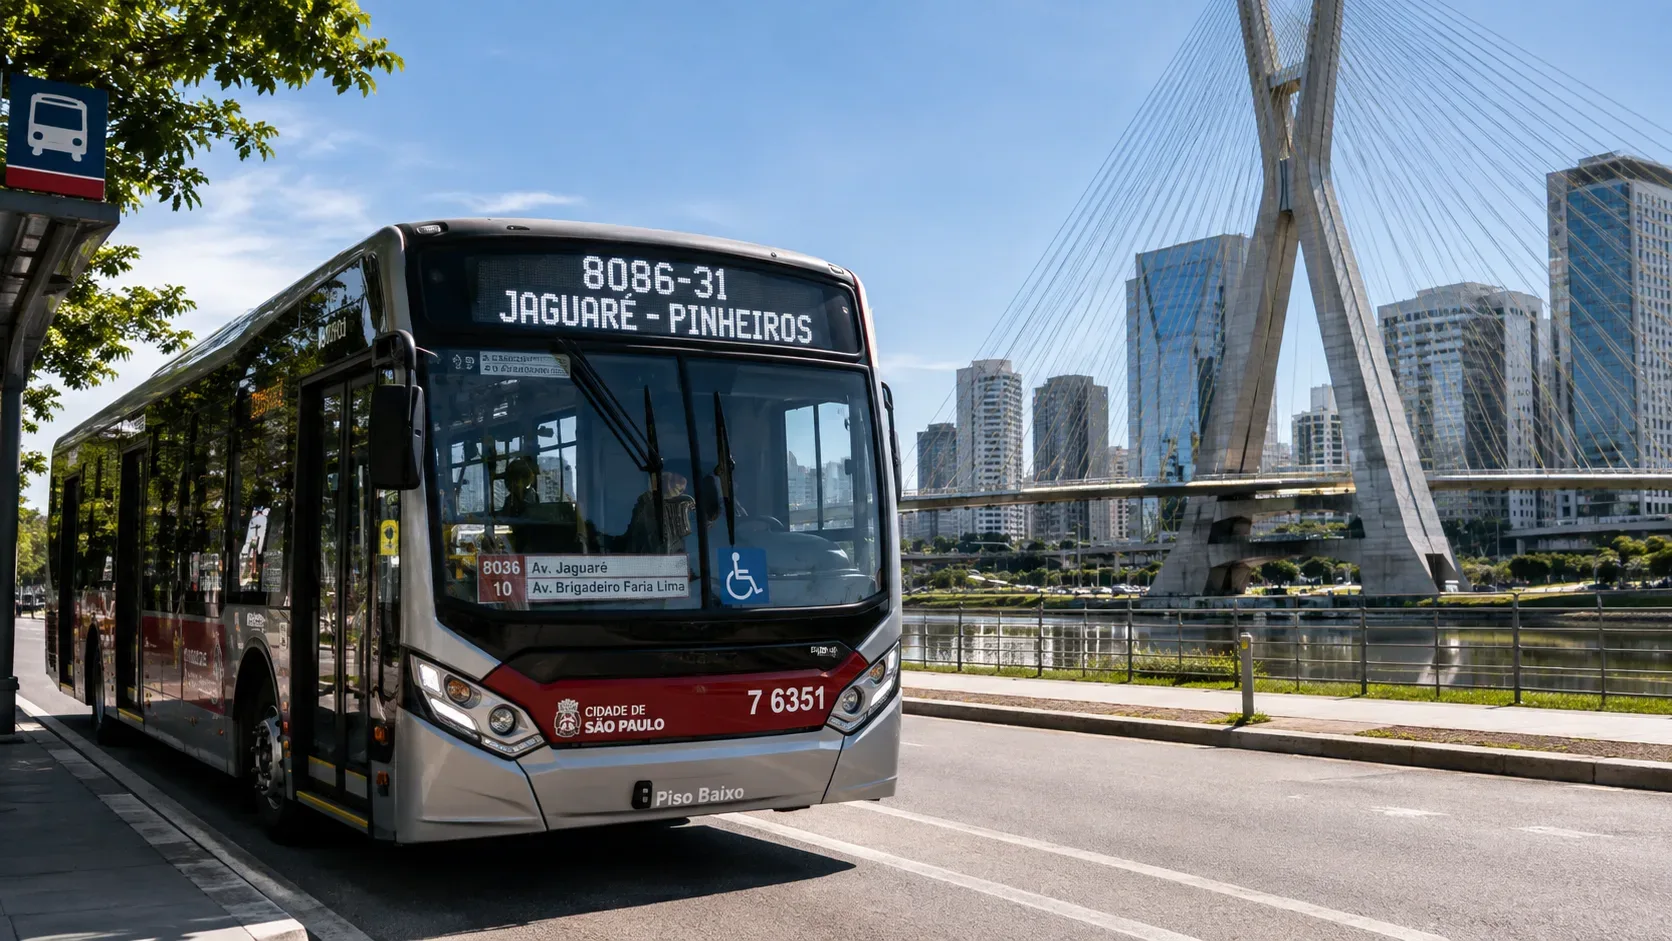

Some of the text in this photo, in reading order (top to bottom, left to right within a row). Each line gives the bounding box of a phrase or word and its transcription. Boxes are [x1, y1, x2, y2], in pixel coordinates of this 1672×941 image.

[583, 256, 727, 300] 8086-31
[499, 290, 637, 330] JAGUARÉ
[669, 303, 812, 344] PINHEIROS
[483, 561, 520, 575] 8036
[532, 561, 608, 576] Av. Jaguaré
[493, 581, 512, 596] 10
[532, 580, 685, 595] Av. Brigadeiro Faria Lima
[748, 685, 824, 715] 7 6351
[585, 704, 646, 717] CIDADE DE
[618, 718, 665, 732] PAULO
[656, 785, 744, 806] Piso Baixo
